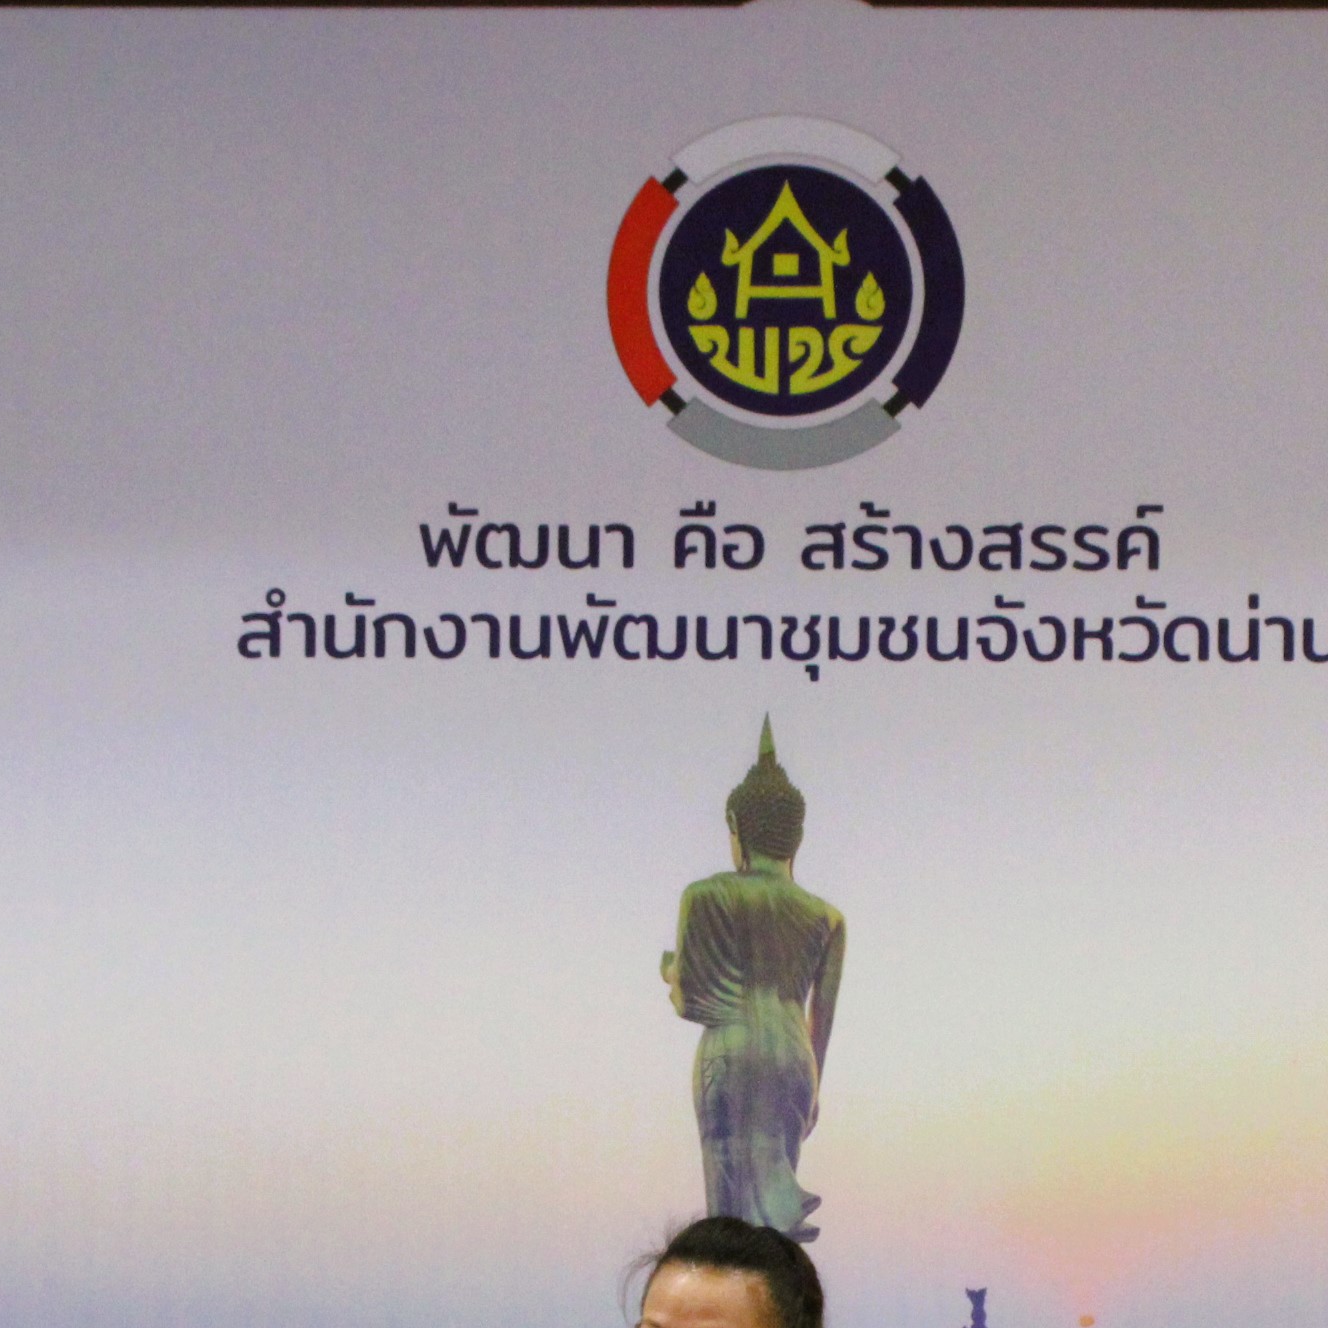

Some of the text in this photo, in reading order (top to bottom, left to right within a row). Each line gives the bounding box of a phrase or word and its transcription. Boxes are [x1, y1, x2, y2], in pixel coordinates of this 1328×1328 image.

[419, 500, 1165, 572] พัฒนา คือ สร้างสรรค์
